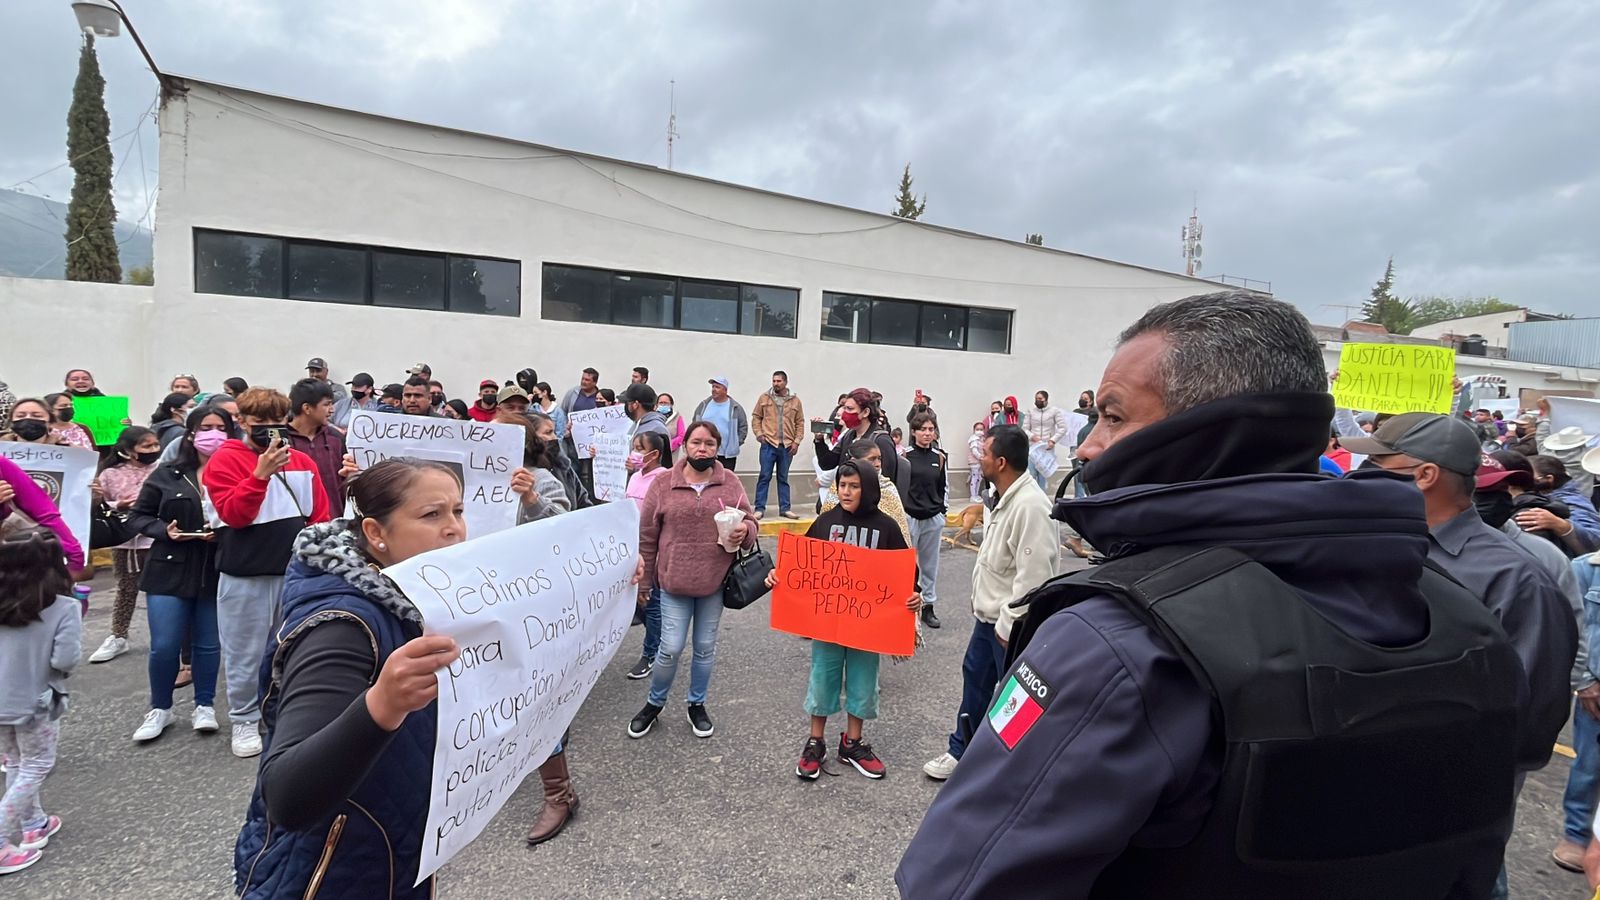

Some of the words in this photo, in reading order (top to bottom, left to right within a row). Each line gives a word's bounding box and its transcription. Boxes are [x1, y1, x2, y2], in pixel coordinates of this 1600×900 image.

[1413, 348, 1454, 371] PARA
[1336, 368, 1417, 399] DANIEL
[352, 414, 455, 442] QUEREMOS
[460, 425, 496, 443] VER
[2, 448, 64, 461] usticia
[469, 451, 510, 474] LAS
[778, 532, 856, 577] FUERA
[416, 564, 552, 620] Pedimos
[553, 535, 631, 610] justicia
[813, 592, 872, 620] PEDRO
[446, 639, 504, 703] para
[586, 590, 605, 615] no
[607, 619, 624, 647] los
[1016, 662, 1048, 698] MEXICO
[435, 787, 493, 856] puta
